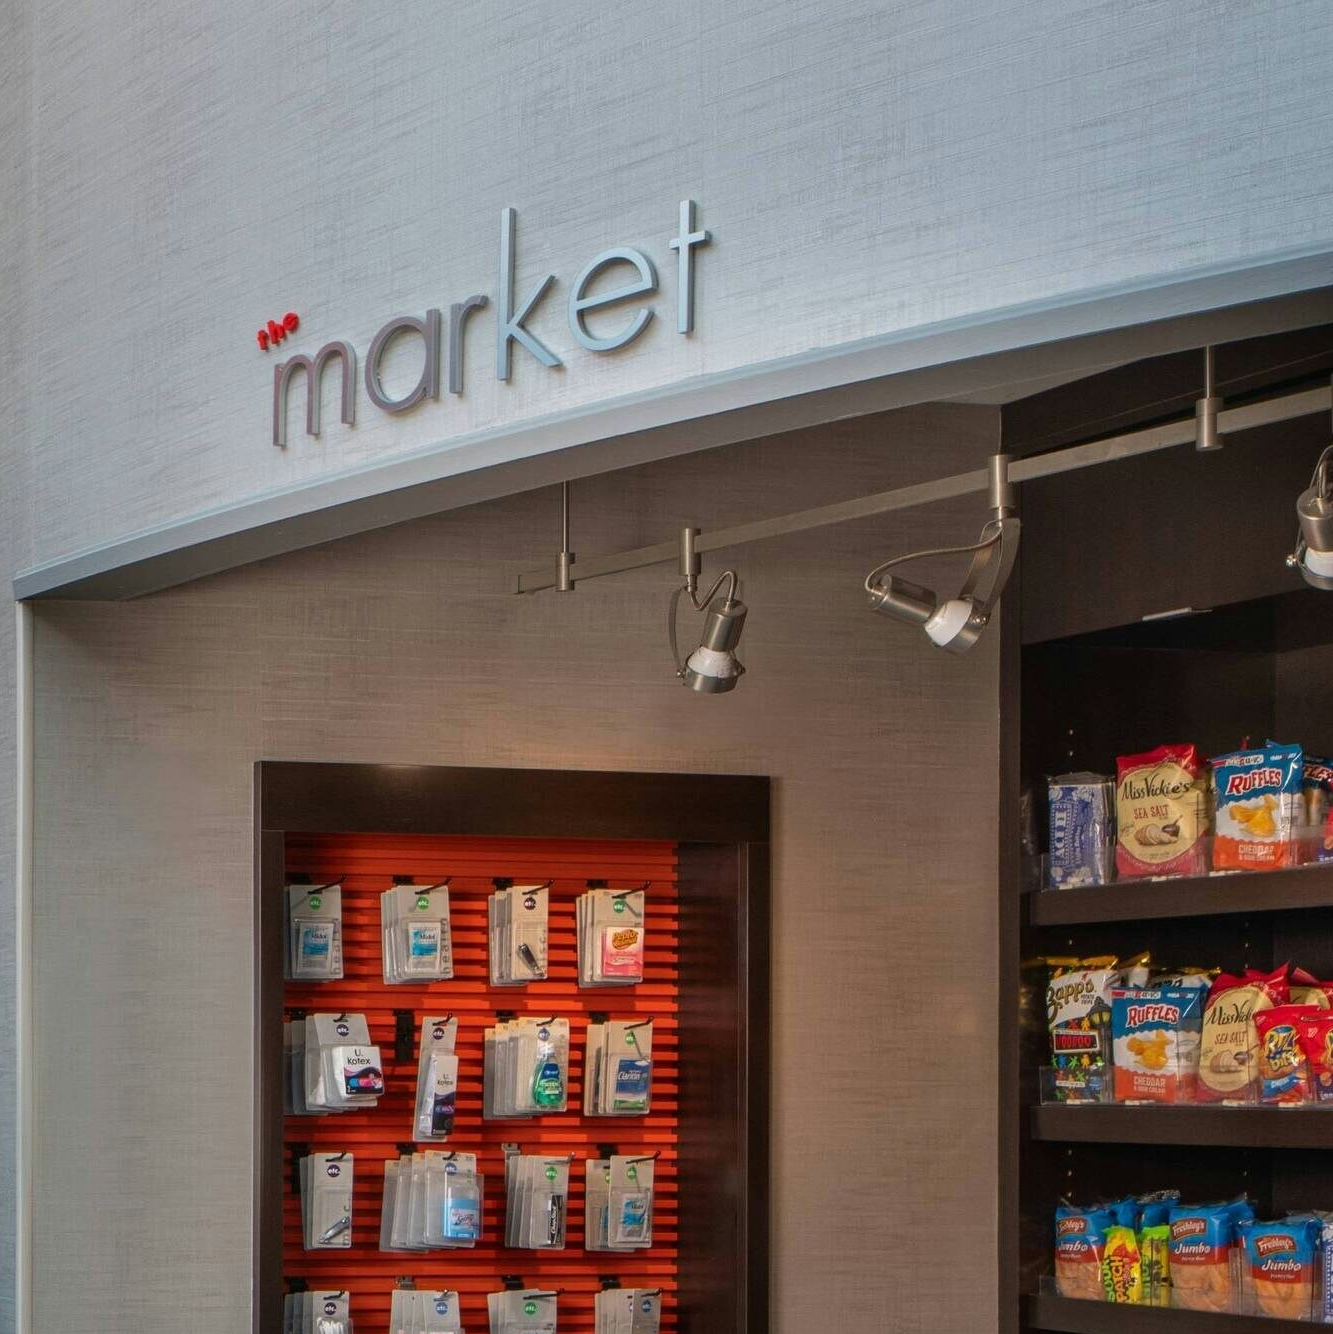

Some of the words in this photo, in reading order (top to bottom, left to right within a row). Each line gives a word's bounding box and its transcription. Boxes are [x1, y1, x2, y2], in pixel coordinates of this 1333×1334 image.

[256, 312, 301, 351] the
[273, 200, 712, 448] market
[1122, 781, 1145, 801] Miss
[1144, 773, 1190, 797] Vickie's
[1226, 768, 1282, 796] RUFFLES
[1134, 806, 1148, 820] SEA
[1151, 804, 1169, 817] SALT
[1126, 1004, 1179, 1027] RUFFLES
[1205, 1006, 1234, 1026] Miss
[1215, 1032, 1229, 1045] SEA
[1229, 1031, 1246, 1043] SALT
[1133, 1076, 1165, 1087] CHEDDAR
[1174, 1242, 1211, 1255] Jumbo
[1261, 1259, 1302, 1271] Jumbo
[1102, 1256, 1115, 1302] SOUR
[1109, 1256, 1127, 1303] PATCH
